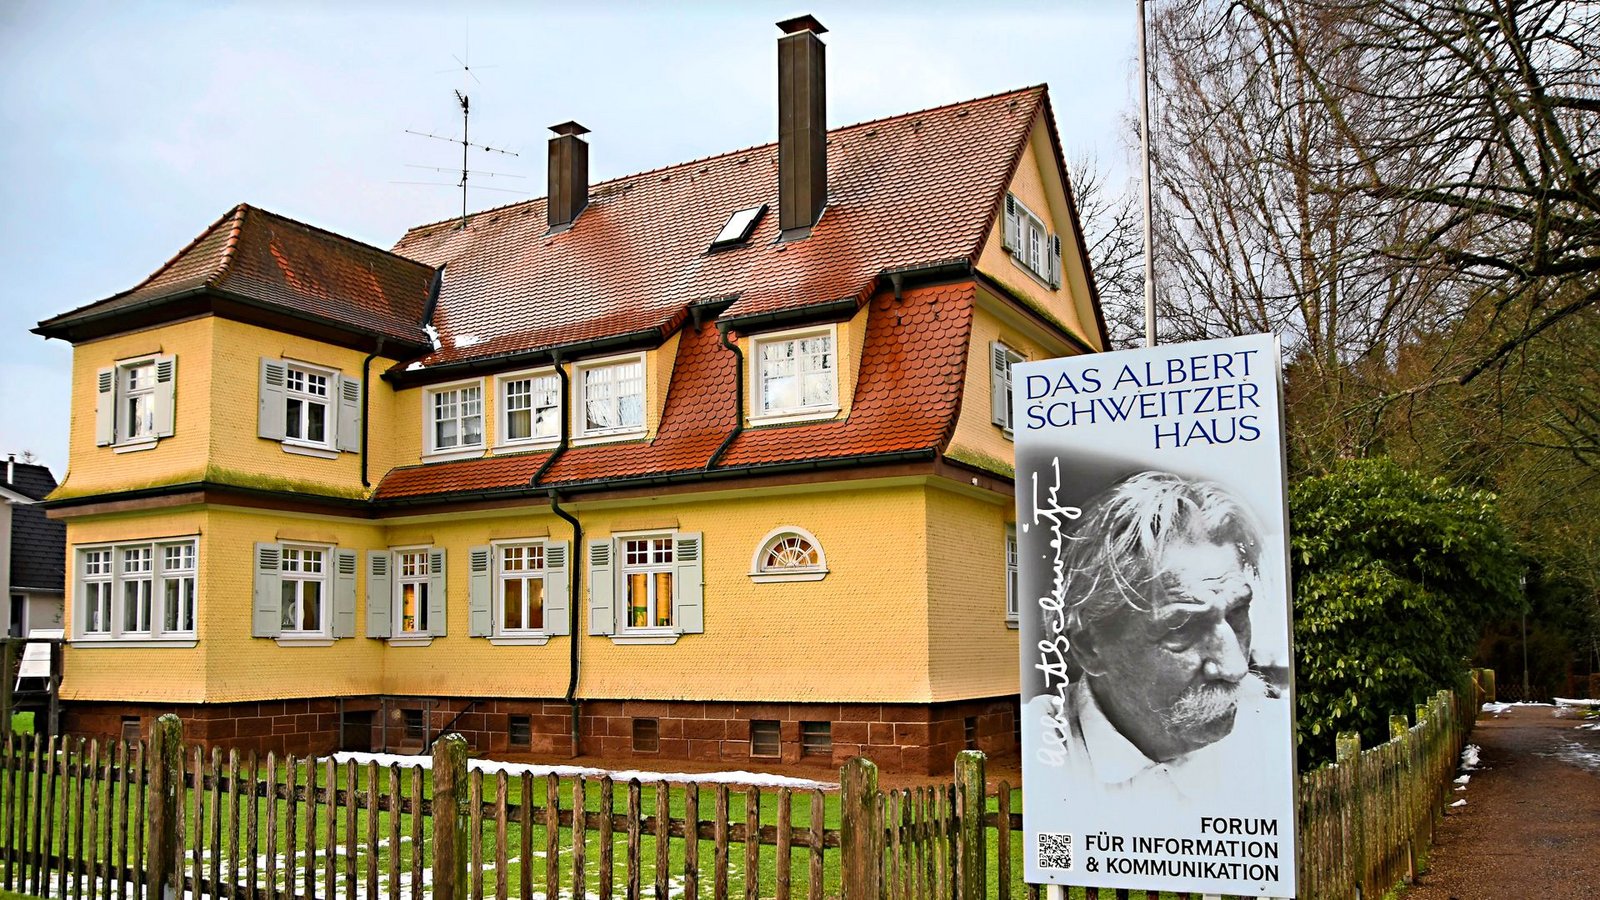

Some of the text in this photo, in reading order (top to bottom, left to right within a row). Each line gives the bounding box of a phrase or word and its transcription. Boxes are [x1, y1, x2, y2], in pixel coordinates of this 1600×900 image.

[1026, 350, 1258, 400] DAS ALBERT
[1026, 383, 1261, 430] SCHWEITZER
[1154, 415, 1261, 449] HAUS
[1200, 817, 1278, 836] FORUM
[1085, 832, 1279, 859] FÜR INFORMATION
[1086, 856, 1280, 882] & KOMMUNIKATION
